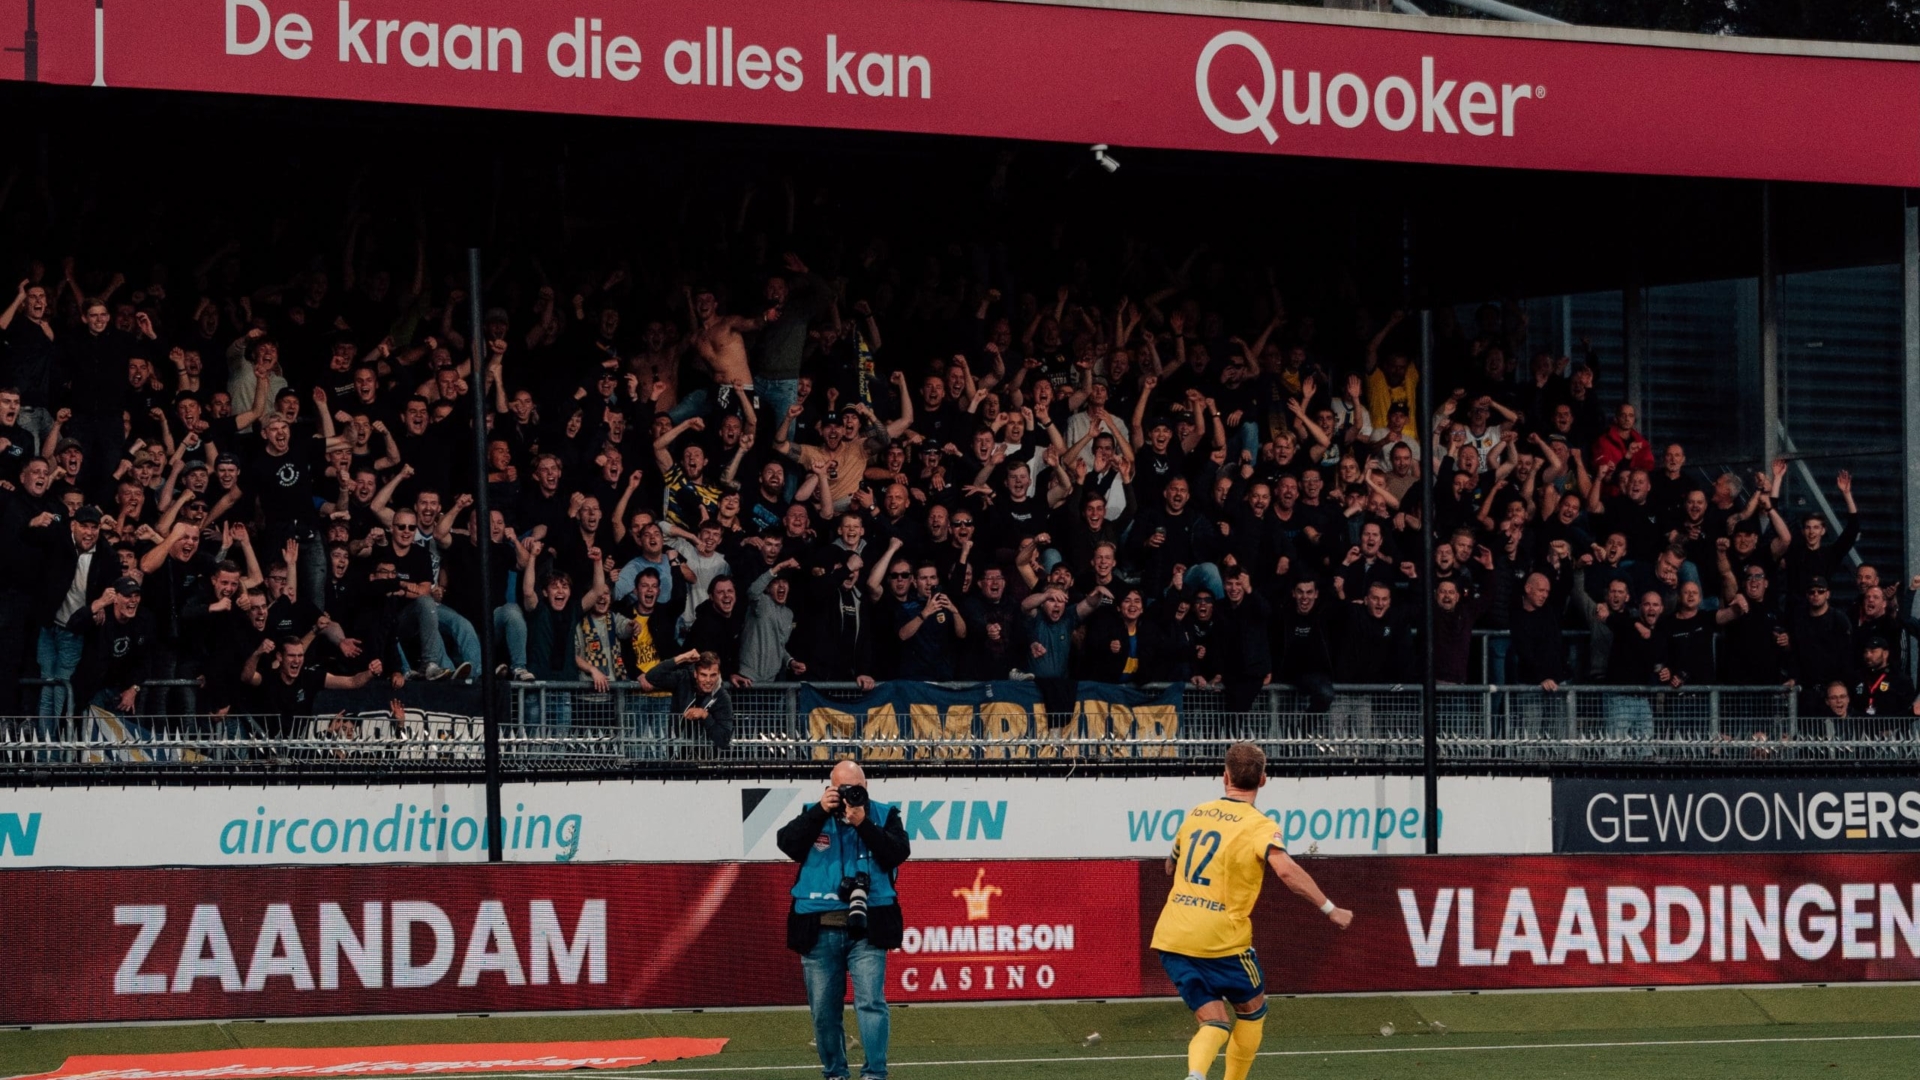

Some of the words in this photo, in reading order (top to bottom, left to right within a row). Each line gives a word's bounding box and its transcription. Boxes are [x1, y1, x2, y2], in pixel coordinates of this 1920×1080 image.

[225, 0, 313, 60] De
[338, 0, 523, 73] kraan
[547, 17, 641, 81] die
[664, 26, 803, 92] alles
[826, 34, 931, 99] kan
[888, 800, 1008, 841] KIN
[1184, 829, 1222, 887] 12
[113, 898, 608, 995] ZAANDAM
[900, 923, 1075, 955] OMMERSON
[1397, 883, 1920, 967] VLAARDINGEN
[900, 964, 1056, 993] CASINO
